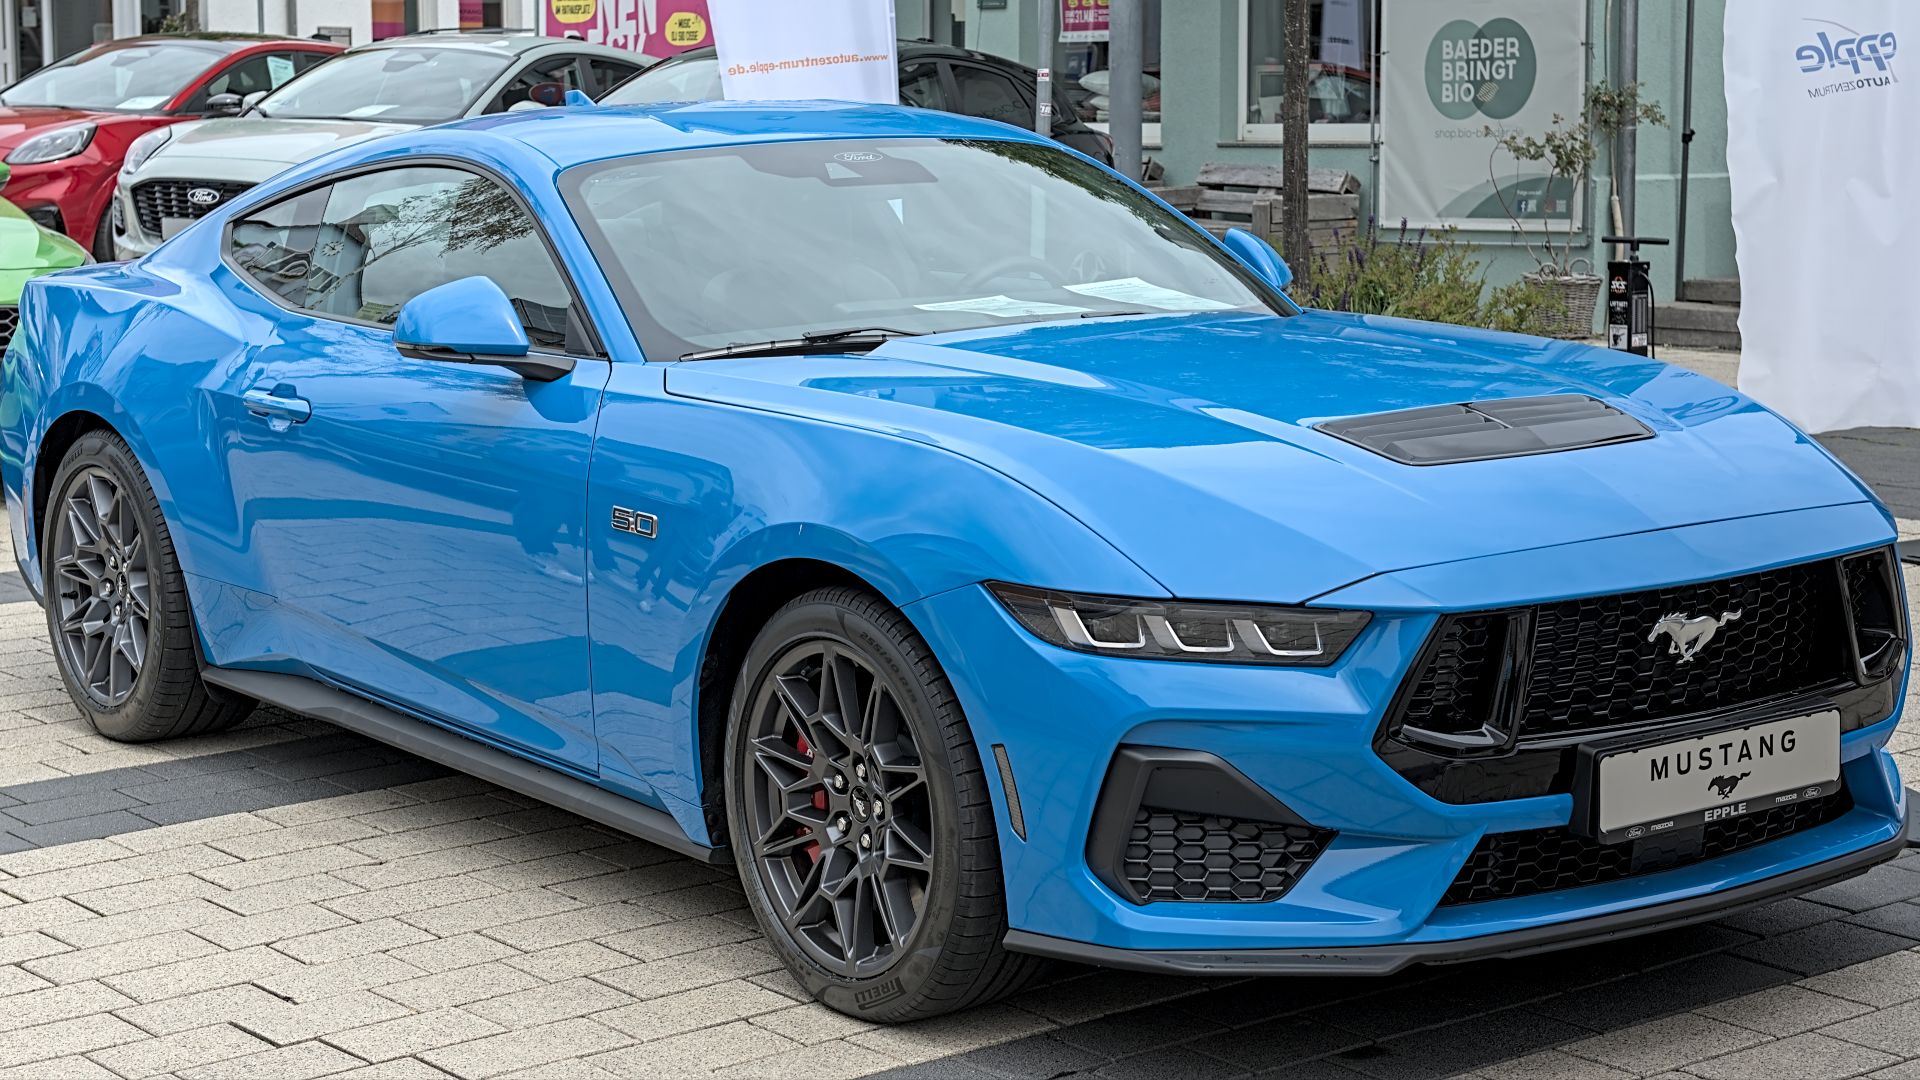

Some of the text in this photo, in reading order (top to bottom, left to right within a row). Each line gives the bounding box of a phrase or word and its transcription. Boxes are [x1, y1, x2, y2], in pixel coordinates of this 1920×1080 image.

[1442, 37, 1520, 60] BAEDER
[1442, 60, 1517, 81] BRINGT
[1442, 83, 1475, 103] BIO
[611, 505, 657, 539] 5.0
[1650, 730, 1796, 782] MUSTANG
[1704, 803, 1747, 822] EPPLE
[1776, 793, 1797, 803] mazda
